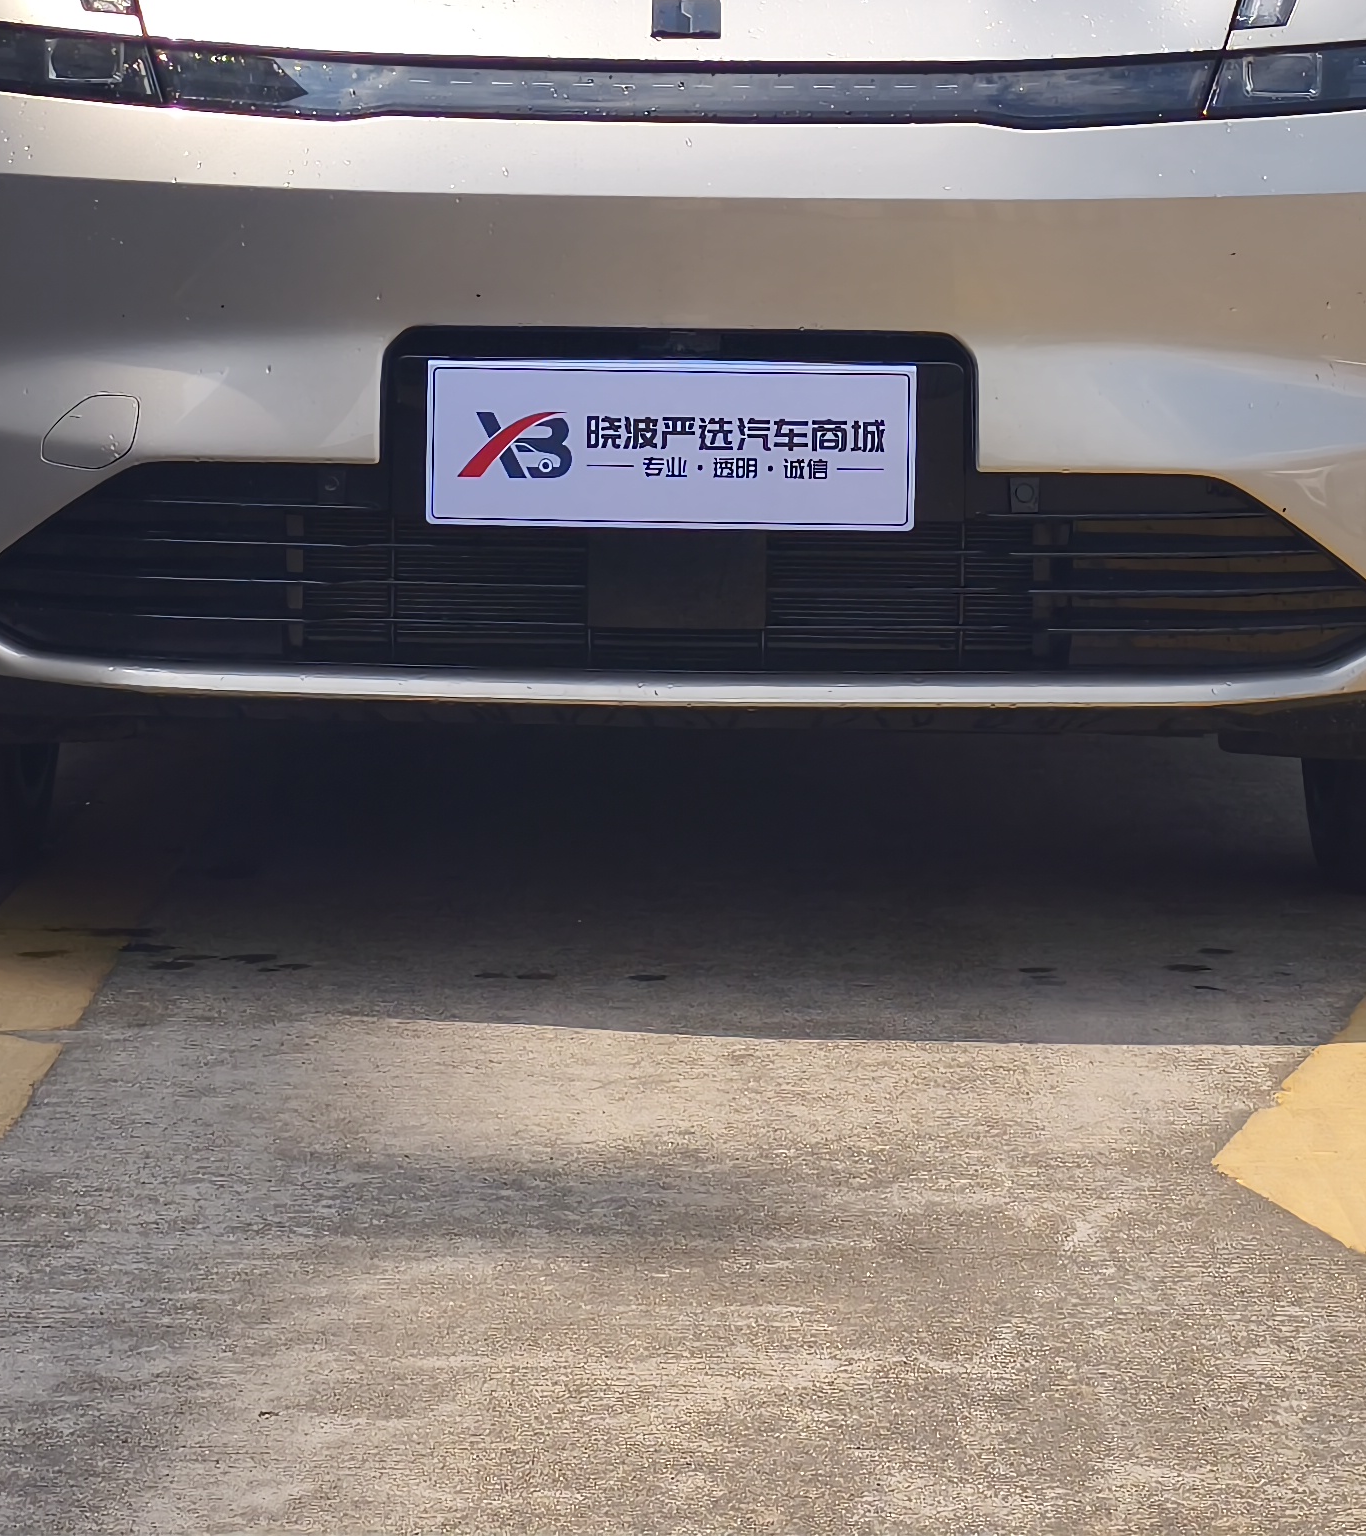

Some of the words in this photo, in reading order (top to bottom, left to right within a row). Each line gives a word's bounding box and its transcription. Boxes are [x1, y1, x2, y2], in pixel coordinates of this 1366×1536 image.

[585, 415, 886, 454] 晓波严选汽车商城
